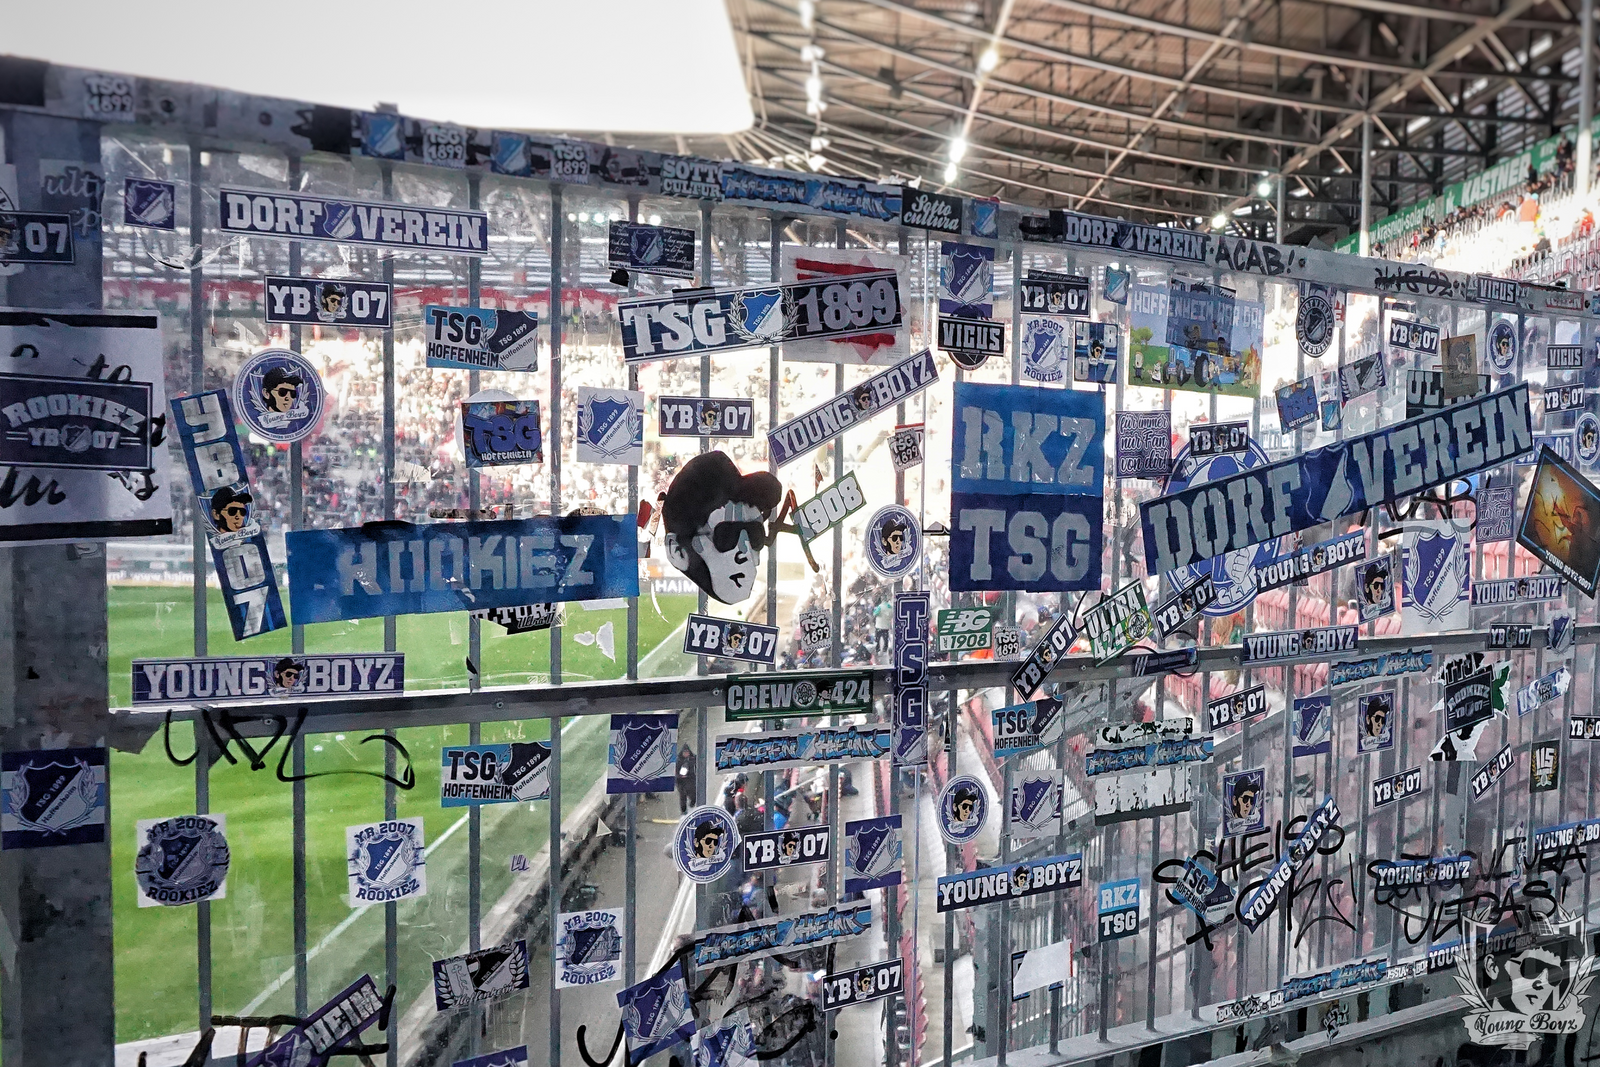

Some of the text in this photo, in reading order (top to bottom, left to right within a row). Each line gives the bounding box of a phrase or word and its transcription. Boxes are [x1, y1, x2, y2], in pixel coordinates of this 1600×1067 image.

[86, 77, 130, 95] TSG
[85, 94, 133, 113] 1899
[426, 128, 461, 145] TSG
[427, 144, 464, 160] 1899
[552, 143, 586, 160] TSG
[554, 159, 588, 175] 1899
[662, 160, 722, 184] SOTT
[1461, 152, 1532, 206] KASTNER
[663, 178, 721, 198] CULTUR
[910, 194, 952, 216] Sotto
[227, 194, 482, 249] DORF VEREIN
[903, 211, 959, 232] cultura
[24, 222, 68, 254] 07
[1066, 216, 1209, 261] DORF VEREIN
[269, 285, 387, 319] YB 07
[1021, 286, 1089, 311] YB 07
[431, 309, 481, 346] TSG
[623, 279, 898, 355] TSG 1899
[1042, 318, 1065, 334] 2007
[500, 336, 534, 362] Hoffenheim
[1391, 323, 1438, 350] YB 07
[428, 342, 500, 369] HOFFENHEIM
[1024, 367, 1064, 383] ROOKIEZ
[775, 353, 933, 460] YOUNG BOYZ
[1545, 387, 1584, 410] YB 07
[2, 393, 146, 434] ROOKIEZ
[662, 404, 751, 430] YB 07
[1119, 414, 1168, 435] für immer
[28, 427, 120, 449] YB 07
[465, 413, 542, 456] TSG
[600, 418, 626, 448] Hoffenheim
[890, 436, 913, 453] TSG
[960, 405, 1096, 486] RKZ
[1120, 431, 1168, 450] nur Fan
[1190, 427, 1248, 452] YB 07
[894, 448, 919, 466] 1899
[1120, 450, 1168, 473] von dir!
[1555, 436, 1570, 460] 06
[1149, 388, 1532, 575] DORF VEREIN
[794, 476, 865, 542] 1908
[958, 508, 1092, 582] TSG
[1257, 535, 1365, 586] YOUNG BOYZ
[1423, 547, 1446, 588] TSG 1899
[1426, 560, 1454, 608] Hoffenheim
[1474, 578, 1561, 604] YOUNG BOYZ
[1157, 579, 1213, 631] YB 07
[802, 613, 828, 629] TSG
[690, 622, 775, 658] YB 07
[803, 628, 830, 645] 1899
[951, 634, 988, 649] 1908
[996, 630, 1017, 644] TSG
[1247, 627, 1356, 661] YOUNG BOYZ
[1490, 626, 1532, 645] YB 07
[899, 595, 928, 728] TSG
[997, 643, 1019, 657] 1899
[1016, 621, 1074, 695] YB 07
[142, 657, 396, 699] YOUNG BOYZ
[727, 679, 871, 711] CREW 424
[1209, 691, 1266, 726] YB 07
[1447, 683, 1491, 712] ROOKIEZ
[995, 710, 1028, 735] TSG
[1571, 719, 1583, 736] YB
[629, 735, 653, 762] TSG 1899
[994, 733, 1040, 750] HOFFENHEIM
[448, 750, 497, 781] TSG
[512, 753, 542, 778] TSG 1899
[633, 743, 660, 775] Hoffenheim
[1472, 749, 1513, 795] YB 07
[35, 775, 66, 809] TSG 1899
[443, 782, 513, 800] HOFFENHEIM
[513, 765, 548, 793] Hoffenheim
[1374, 772, 1421, 802] YB 07
[40, 785, 77, 824] Hoffenheim
[175, 817, 219, 833] 2007
[354, 822, 416, 843] YB 2007
[746, 832, 829, 865] YB 07
[866, 843, 888, 873] Hoffenheim
[1244, 799, 1339, 923] YOUNG BOYZ
[939, 858, 1081, 907] YOUNG BOYZ
[1184, 860, 1208, 895] TSG
[1378, 859, 1471, 886] YOUNG BOYZ
[146, 879, 219, 902] ROOKIEZ
[355, 878, 420, 901] ROOKIEZ
[1101, 883, 1138, 910] RKZ
[1175, 879, 1208, 915] HOFFENHEIM
[585, 911, 617, 925] 2007
[1100, 911, 1137, 937] TSG
[560, 965, 617, 985] ROOKIEZ
[824, 966, 901, 1003] YB 07
[304, 982, 384, 1055] HEIM
[653, 999, 671, 1036] Hoffenheim
